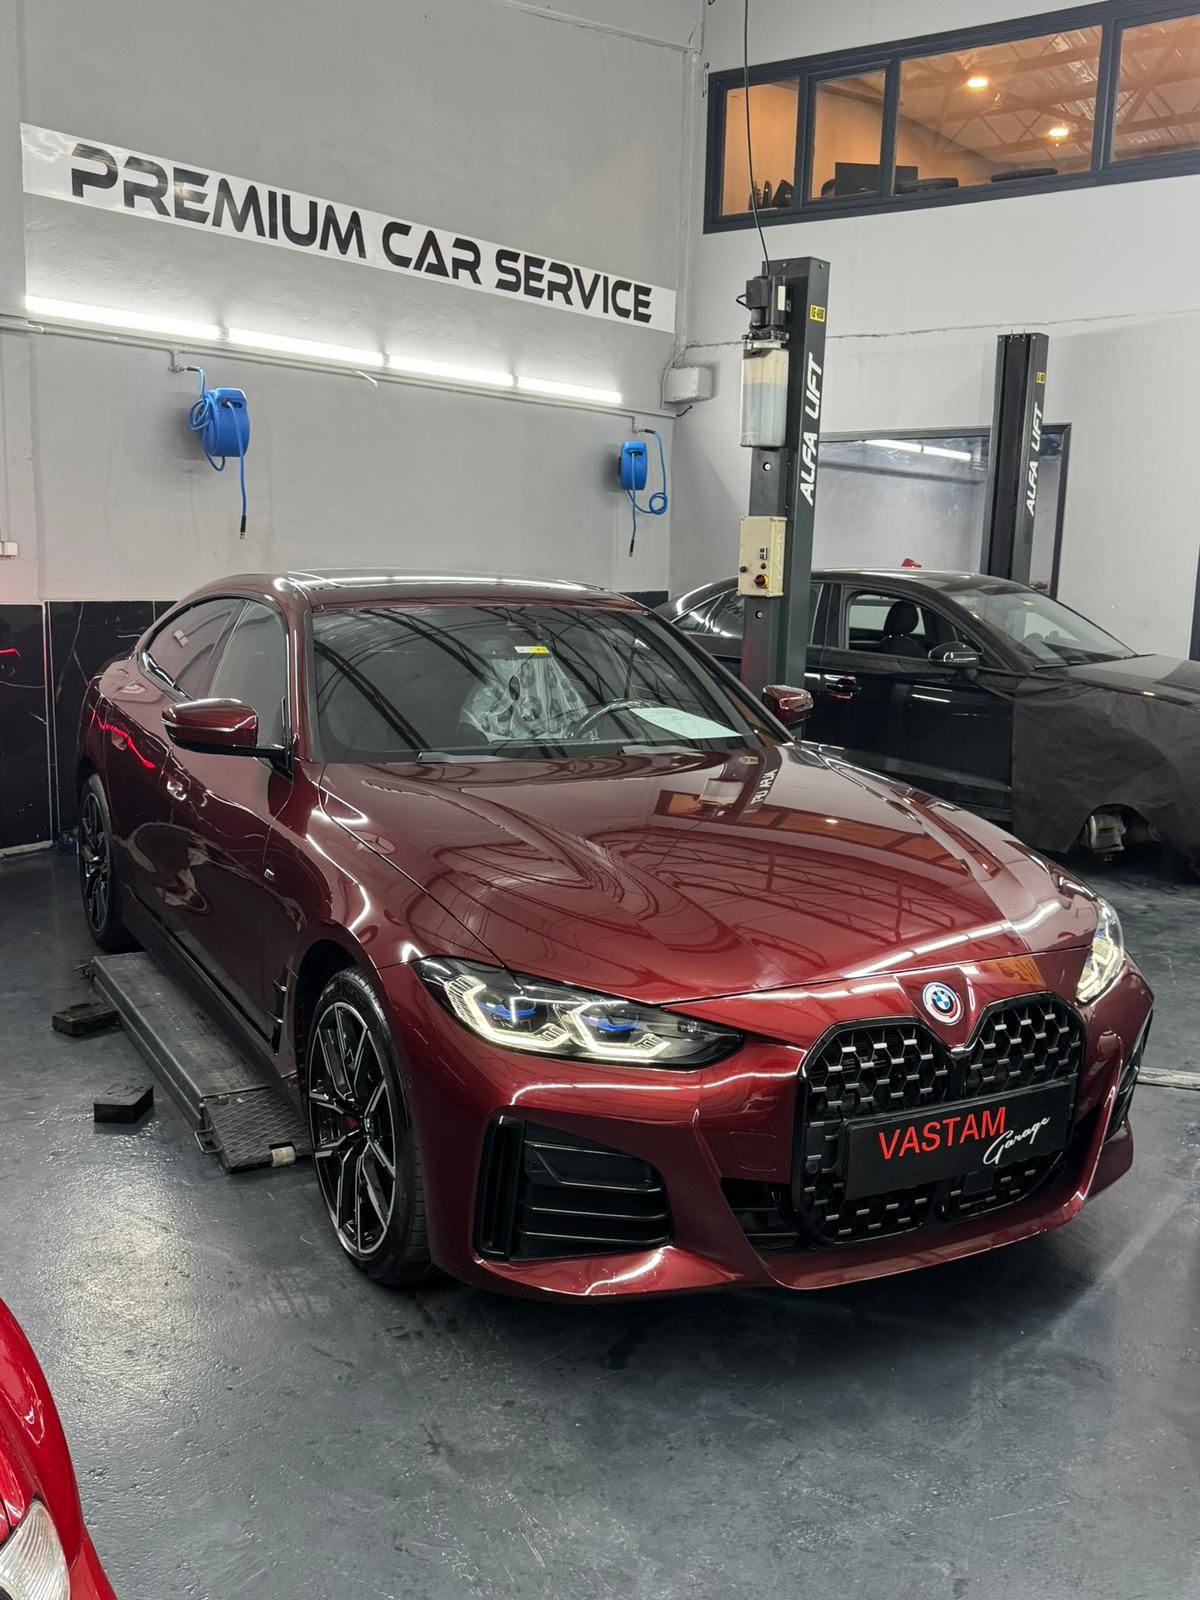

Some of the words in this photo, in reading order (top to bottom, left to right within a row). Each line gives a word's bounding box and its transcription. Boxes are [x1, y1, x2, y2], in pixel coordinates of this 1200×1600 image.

[71, 142, 366, 259] PREMIUM
[381, 221, 482, 285] CAR
[495, 248, 653, 324] SERVICE
[805, 352, 822, 420] LIFT
[1031, 402, 1043, 452] LIFT
[800, 431, 818, 506] ALFA
[1025, 461, 1038, 517] ALFA
[878, 1106, 1006, 1160] VASTAM
[982, 1116, 1050, 1165] Garage
